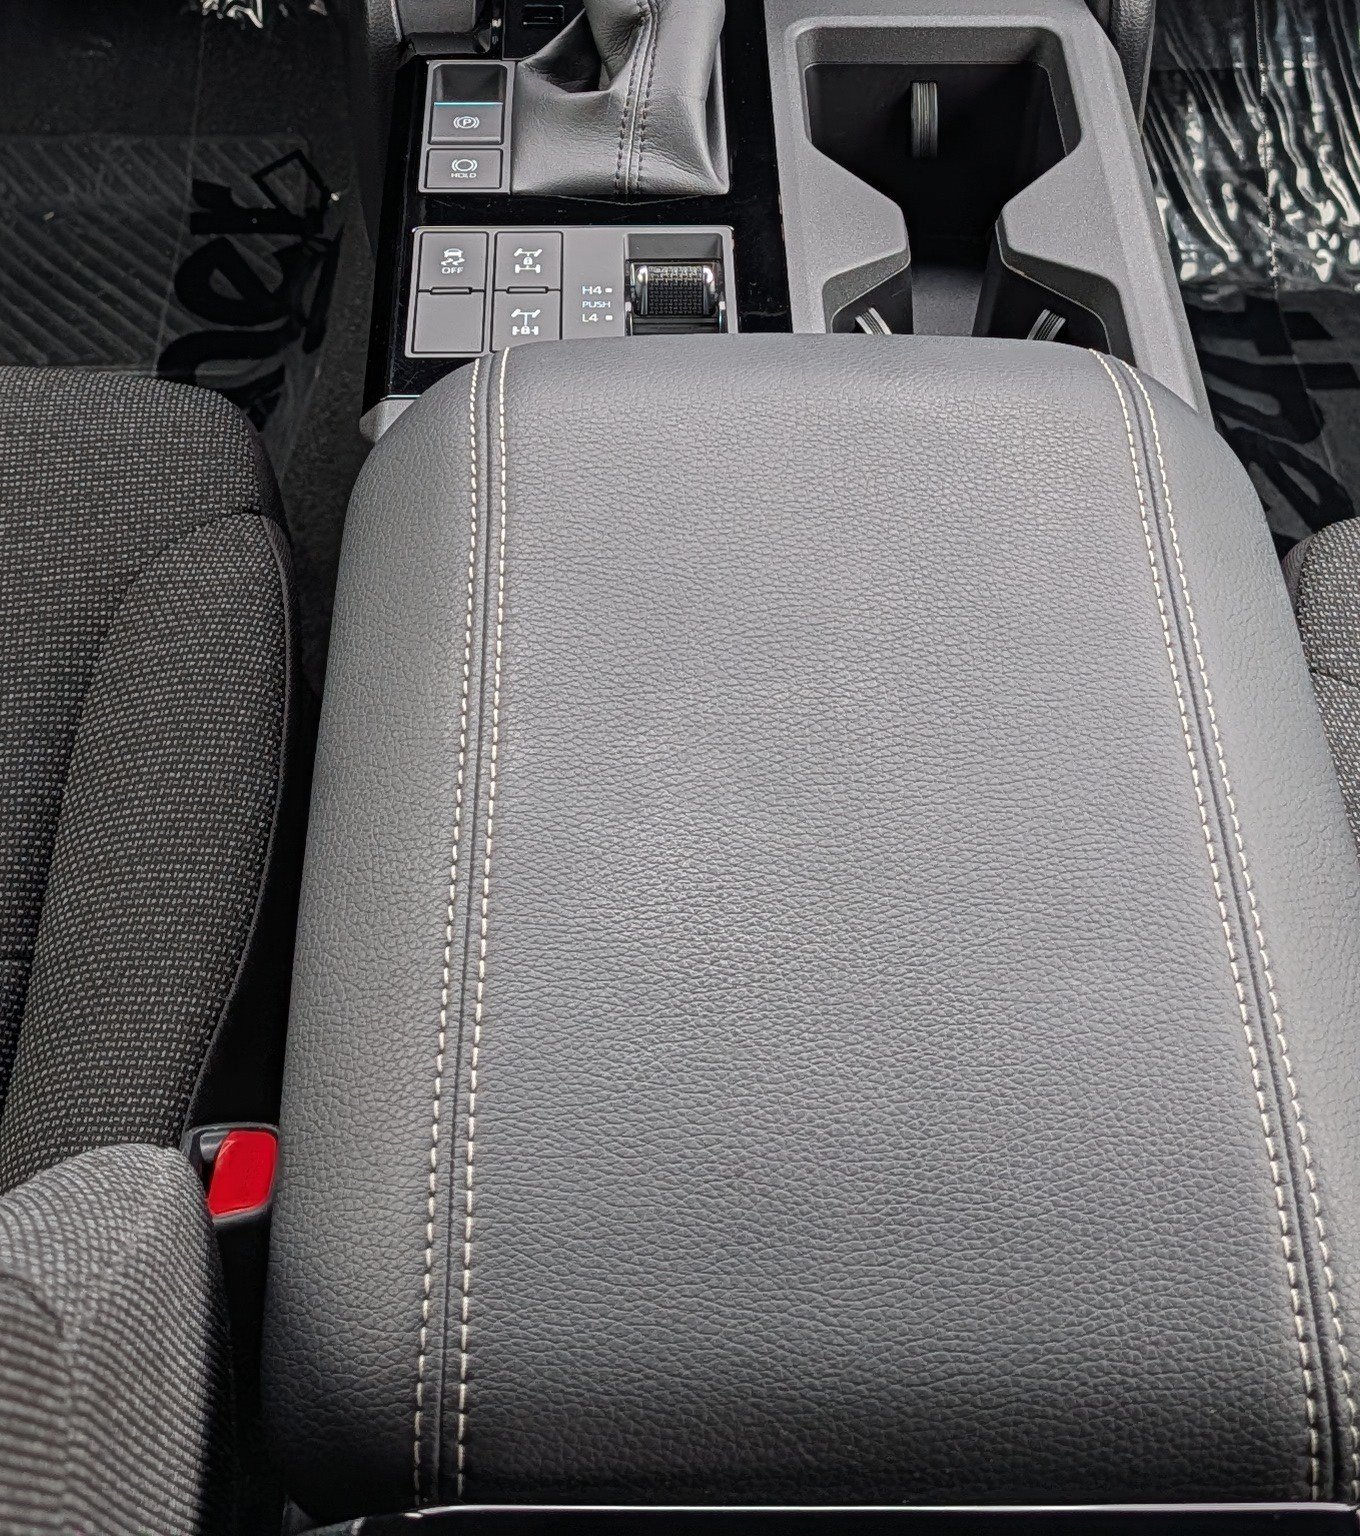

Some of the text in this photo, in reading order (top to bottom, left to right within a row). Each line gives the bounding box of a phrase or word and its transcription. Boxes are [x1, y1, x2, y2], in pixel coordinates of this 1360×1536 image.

[441, 266, 464, 274] OFF
[582, 286, 602, 295] H4
[582, 314, 598, 322] L4
